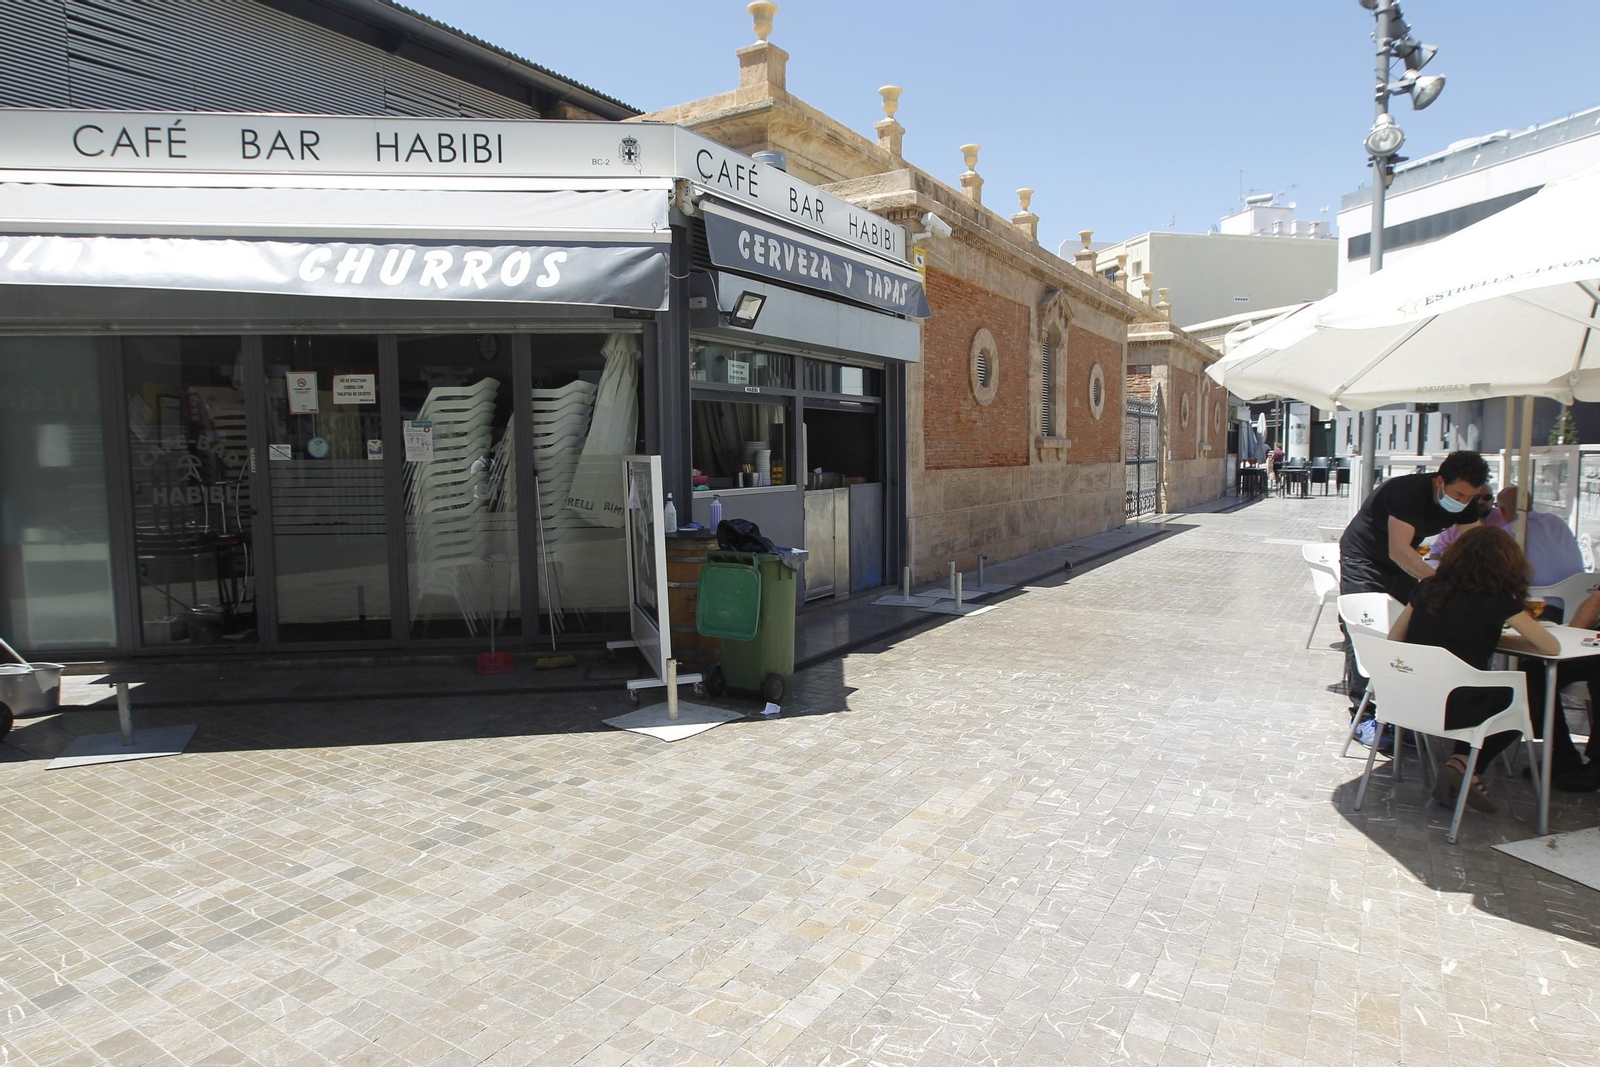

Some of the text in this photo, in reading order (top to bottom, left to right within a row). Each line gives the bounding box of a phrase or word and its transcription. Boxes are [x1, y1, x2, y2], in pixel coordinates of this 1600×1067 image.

[73, 120, 503, 164] CAFÉ BAR HABIBI
[591, 158, 610, 166] BC-2
[696, 148, 896, 253] CAFÉ BAR HABIBI
[298, 246, 568, 290] CHURROS
[738, 230, 908, 306] CERVEZA Y TAPAS
[1424, 274, 1514, 306] ESTRELLA
[153, 486, 231, 504] HABIBI
